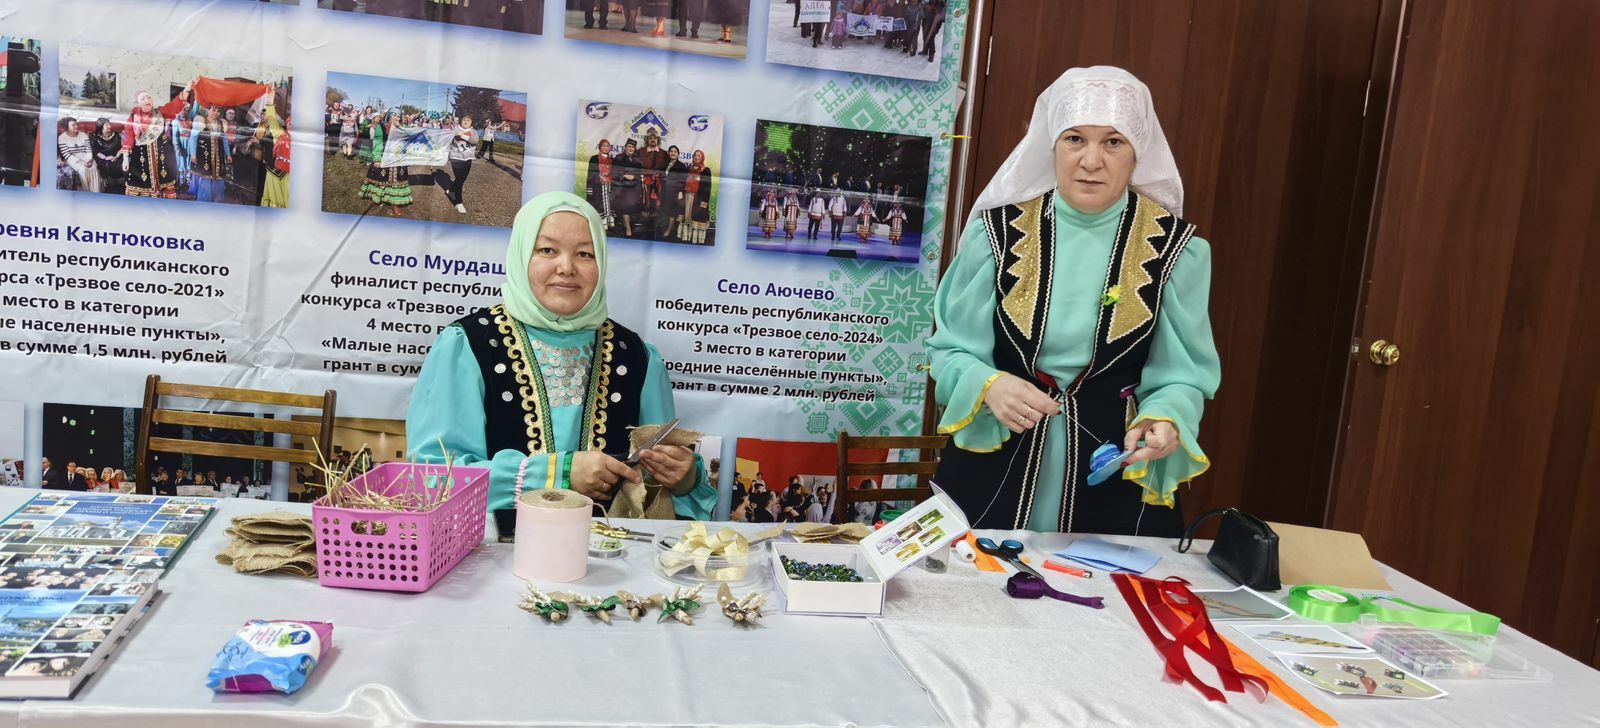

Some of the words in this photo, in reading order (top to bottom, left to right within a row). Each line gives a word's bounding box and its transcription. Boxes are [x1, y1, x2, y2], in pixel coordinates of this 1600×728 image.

[0, 222, 60, 240] евня
[66, 225, 206, 252] Кантюковка
[0, 249, 52, 264] итель
[56, 252, 230, 277] республиканского
[368, 249, 418, 268] Село
[423, 253, 507, 276] Мурдаш
[34, 274, 121, 291] «Трезвое
[125, 281, 226, 298] село-2021»
[330, 271, 419, 291] финалист
[422, 281, 504, 298] республи
[717, 278, 761, 296] Село
[764, 282, 835, 301] Аючево
[2, 295, 59, 310] место
[64, 299, 76, 311] в
[80, 300, 179, 319] категории
[300, 293, 382, 311] конкурса
[386, 298, 466, 316] «Трезвое
[655, 298, 749, 316] победитель
[751, 305, 890, 326] республиканского
[21, 319, 136, 337] населенные
[141, 325, 226, 345] пункты»,
[366, 317, 377, 331] 4
[380, 320, 432, 335] место
[657, 318, 729, 336] конкурса
[732, 324, 802, 341] «Трезвое
[805, 328, 884, 345] село-2024»
[0, 340, 12, 351] в
[16, 341, 78, 356] сумме
[83, 343, 109, 358] 1,5
[113, 346, 156, 360] млн.
[161, 347, 228, 364] рублей
[321, 336, 392, 353] «Малые
[693, 340, 703, 353] 3
[706, 343, 752, 356] место
[755, 346, 765, 357] в
[768, 347, 847, 364] категории
[323, 359, 372, 373] грант
[376, 362, 387, 373] в
[391, 363, 422, 377] сум
[661, 359, 722, 374] редние
[725, 364, 817, 381] населённые
[820, 370, 888, 387] пункты»,
[669, 380, 704, 393] ант
[706, 382, 717, 393] в
[720, 382, 769, 397] сумме
[772, 384, 781, 397] 2
[783, 387, 819, 400] млн.
[822, 387, 876, 403] рублей
